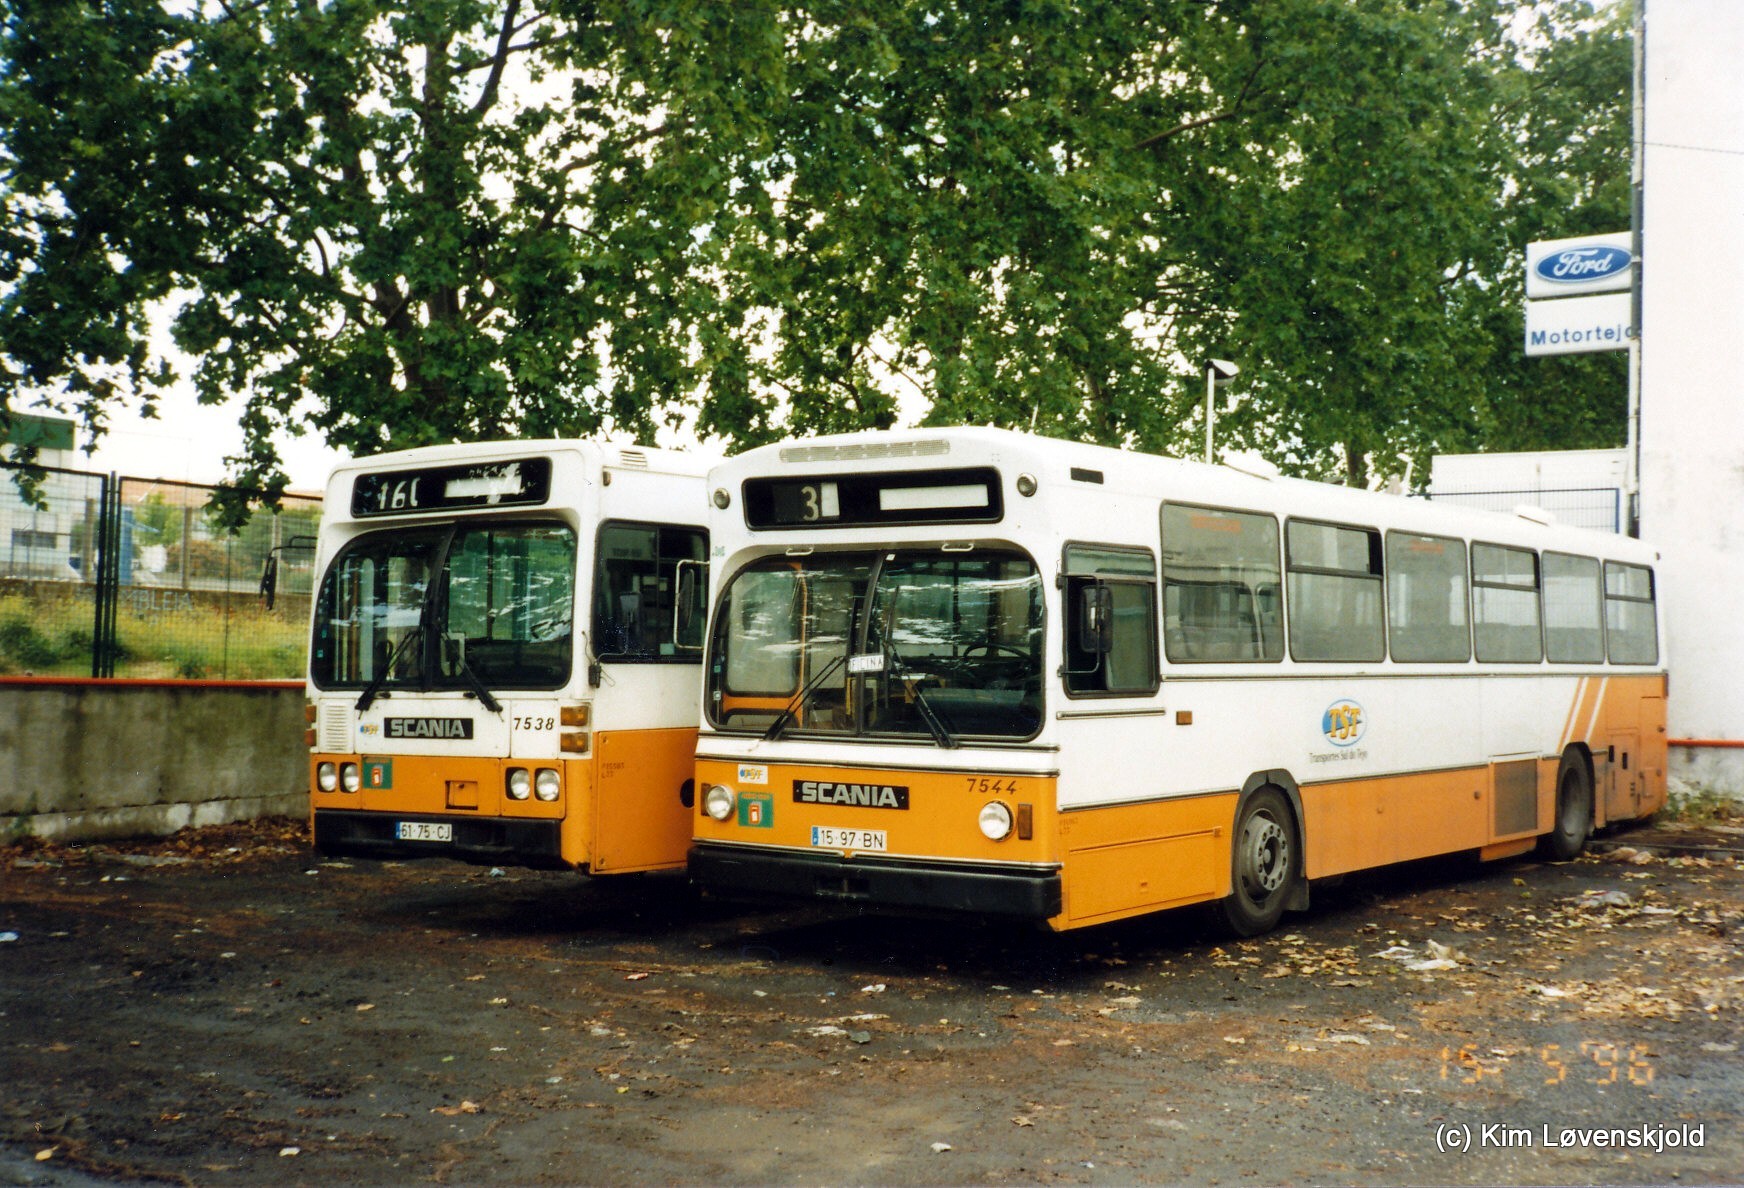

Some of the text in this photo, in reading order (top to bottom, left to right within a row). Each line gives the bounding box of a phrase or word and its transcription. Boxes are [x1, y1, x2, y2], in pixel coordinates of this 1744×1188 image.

[1553, 249, 1613, 276] Ford
[390, 718, 465, 738] SCANIA
[513, 717, 555, 731] 7538
[1329, 705, 1360, 740] TST
[802, 781, 899, 808] SCANIA
[967, 778, 1017, 795] 7544
